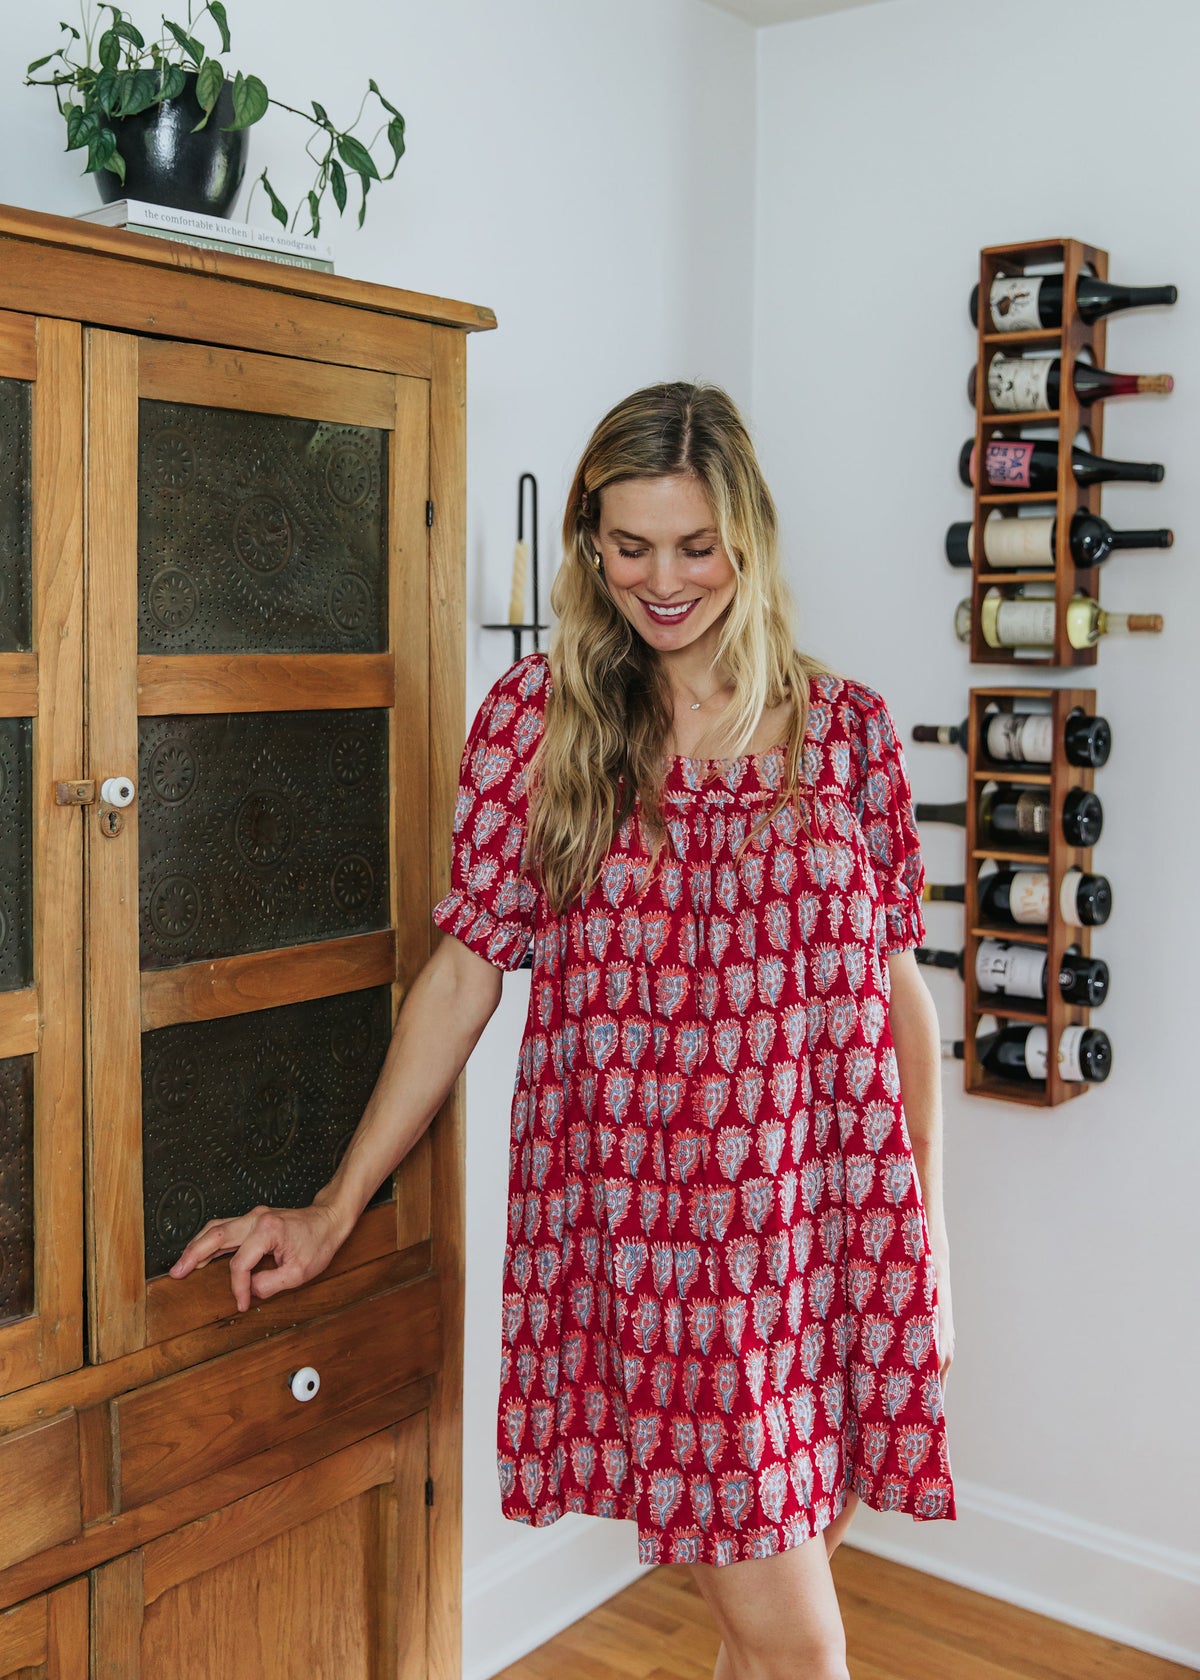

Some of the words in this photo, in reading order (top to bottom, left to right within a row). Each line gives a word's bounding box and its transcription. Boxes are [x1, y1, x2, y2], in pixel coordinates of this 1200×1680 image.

[144, 208, 160, 220] the
[160, 213, 214, 231] comfortable
[215, 222, 248, 238] kitchen
[257, 233, 275, 244] alex
[276, 237, 317, 252] snodgrass
[234, 248, 272, 262] dinner
[274, 255, 312, 271] tonight
